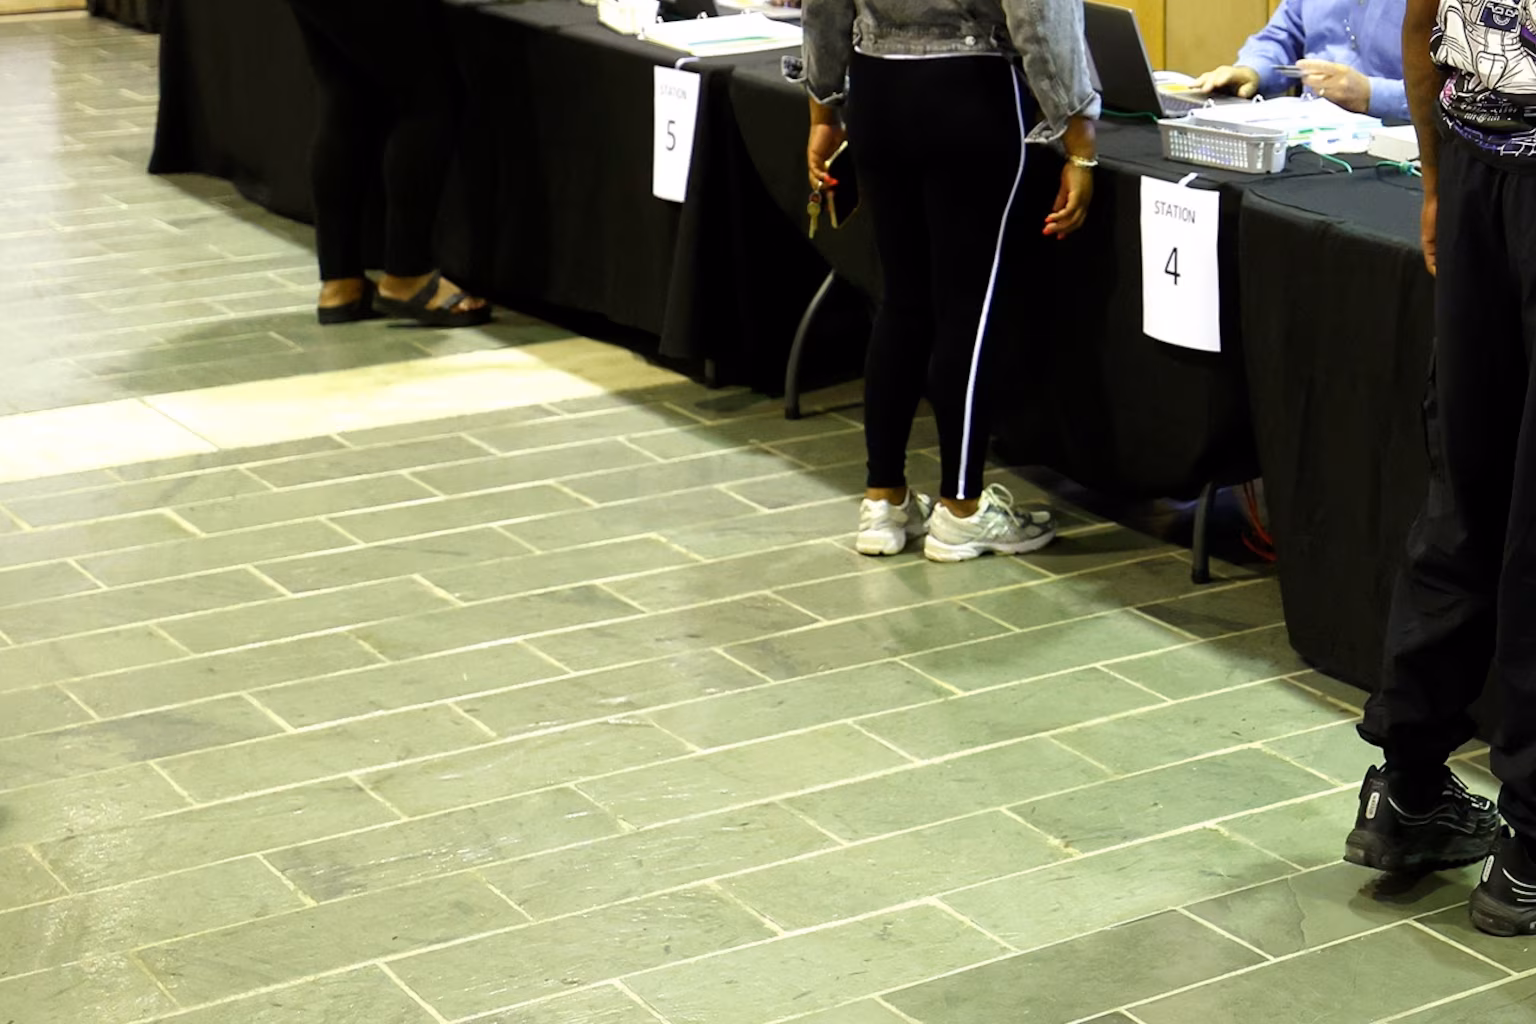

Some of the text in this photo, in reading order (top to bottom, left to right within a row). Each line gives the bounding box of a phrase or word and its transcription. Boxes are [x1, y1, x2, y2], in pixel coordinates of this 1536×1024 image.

[666, 119, 676, 151] 5
[1154, 200, 1195, 224] STATION
[1164, 246, 1181, 286] 4
